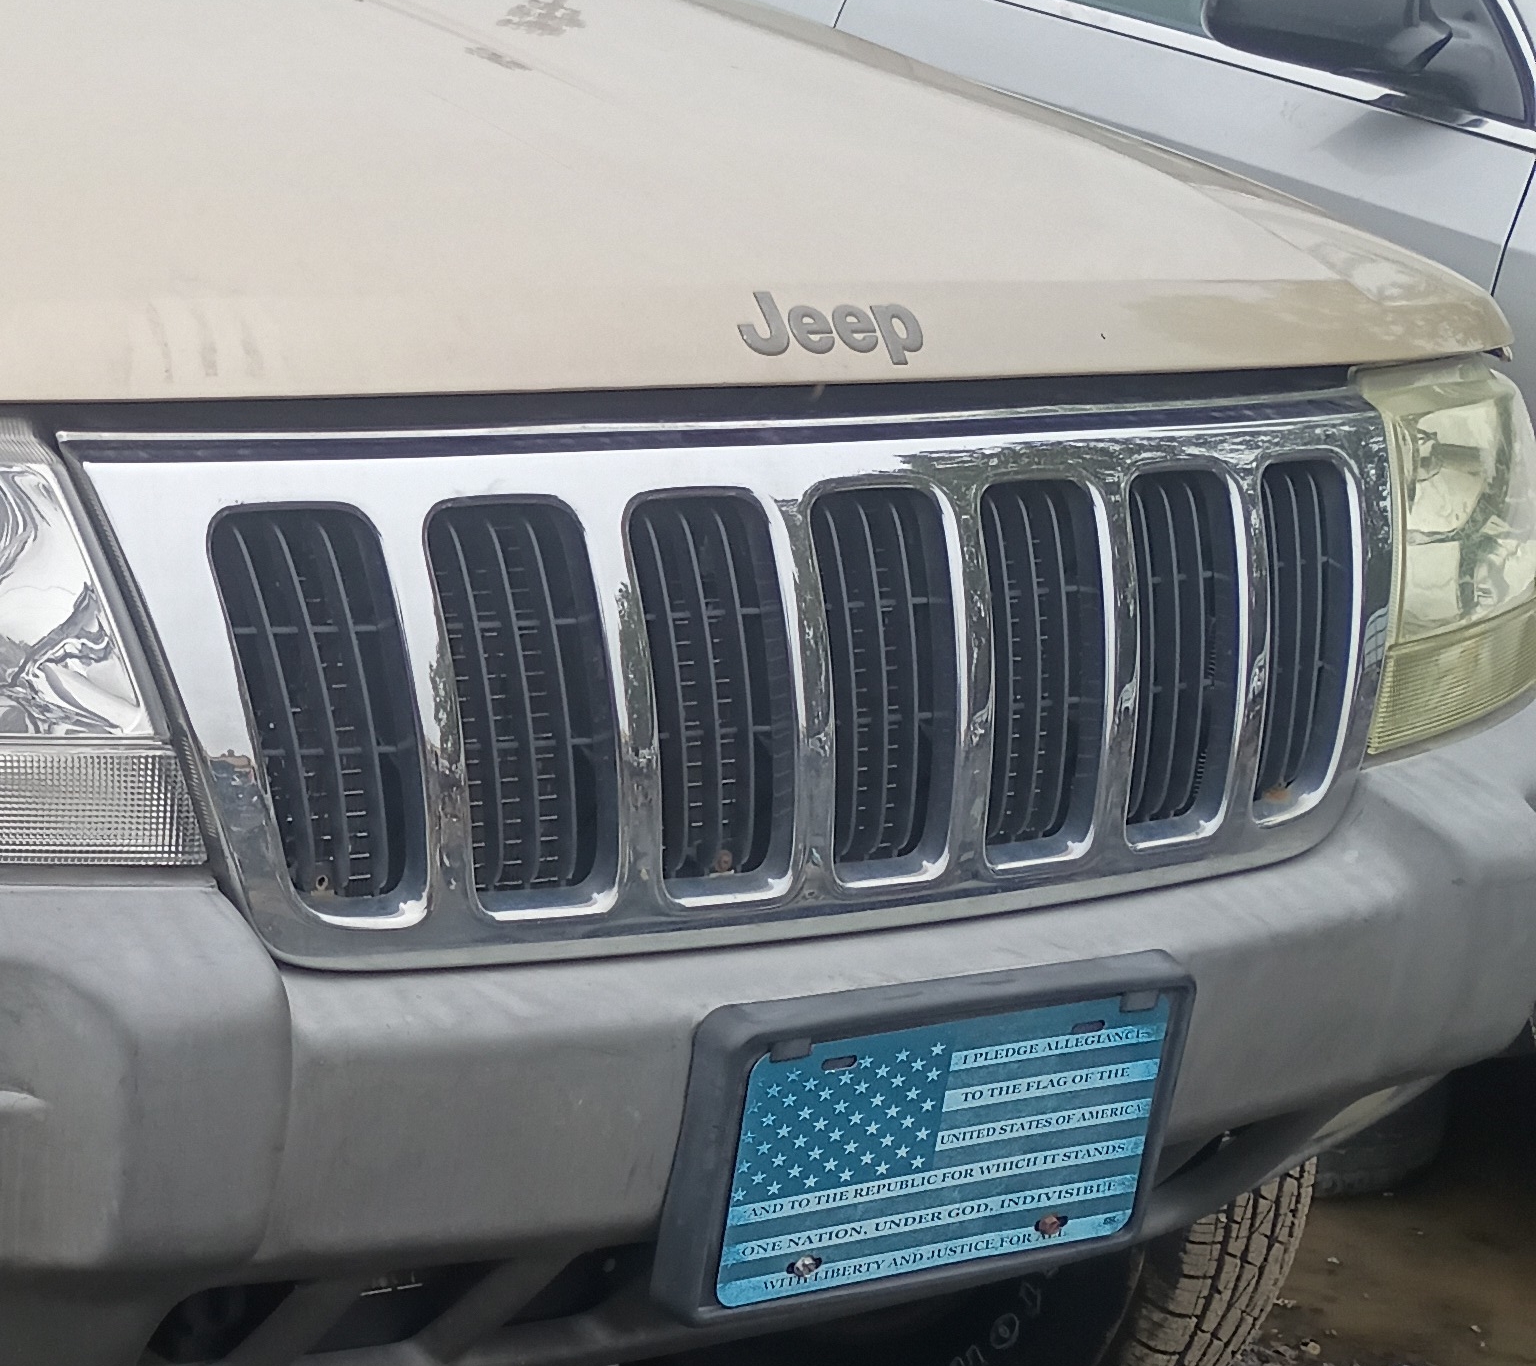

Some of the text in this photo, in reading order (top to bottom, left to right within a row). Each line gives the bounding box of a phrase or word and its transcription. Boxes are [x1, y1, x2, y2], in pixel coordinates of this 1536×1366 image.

[737, 290, 924, 366] Jeep
[962, 1030, 1151, 1064] I PLEDGE ALLEGIANCE
[961, 1067, 1130, 1101] TO THE FLAG OF THE
[940, 1104, 1142, 1145] UNITED STATES OF AMERICA
[749, 1143, 1126, 1217] AND TO THE REPUBLIC FOR WHICH IT STANDS
[741, 1240, 783, 1256] ONE
[874, 1210, 943, 1231] UNDER
[1000, 1182, 1116, 1209] INDIVISIBLE
[814, 1259, 885, 1282] LIBERTY
[887, 1253, 924, 1268] AND
[927, 1238, 996, 1261] JUSTICE
[999, 1233, 1033, 1247] FOR
